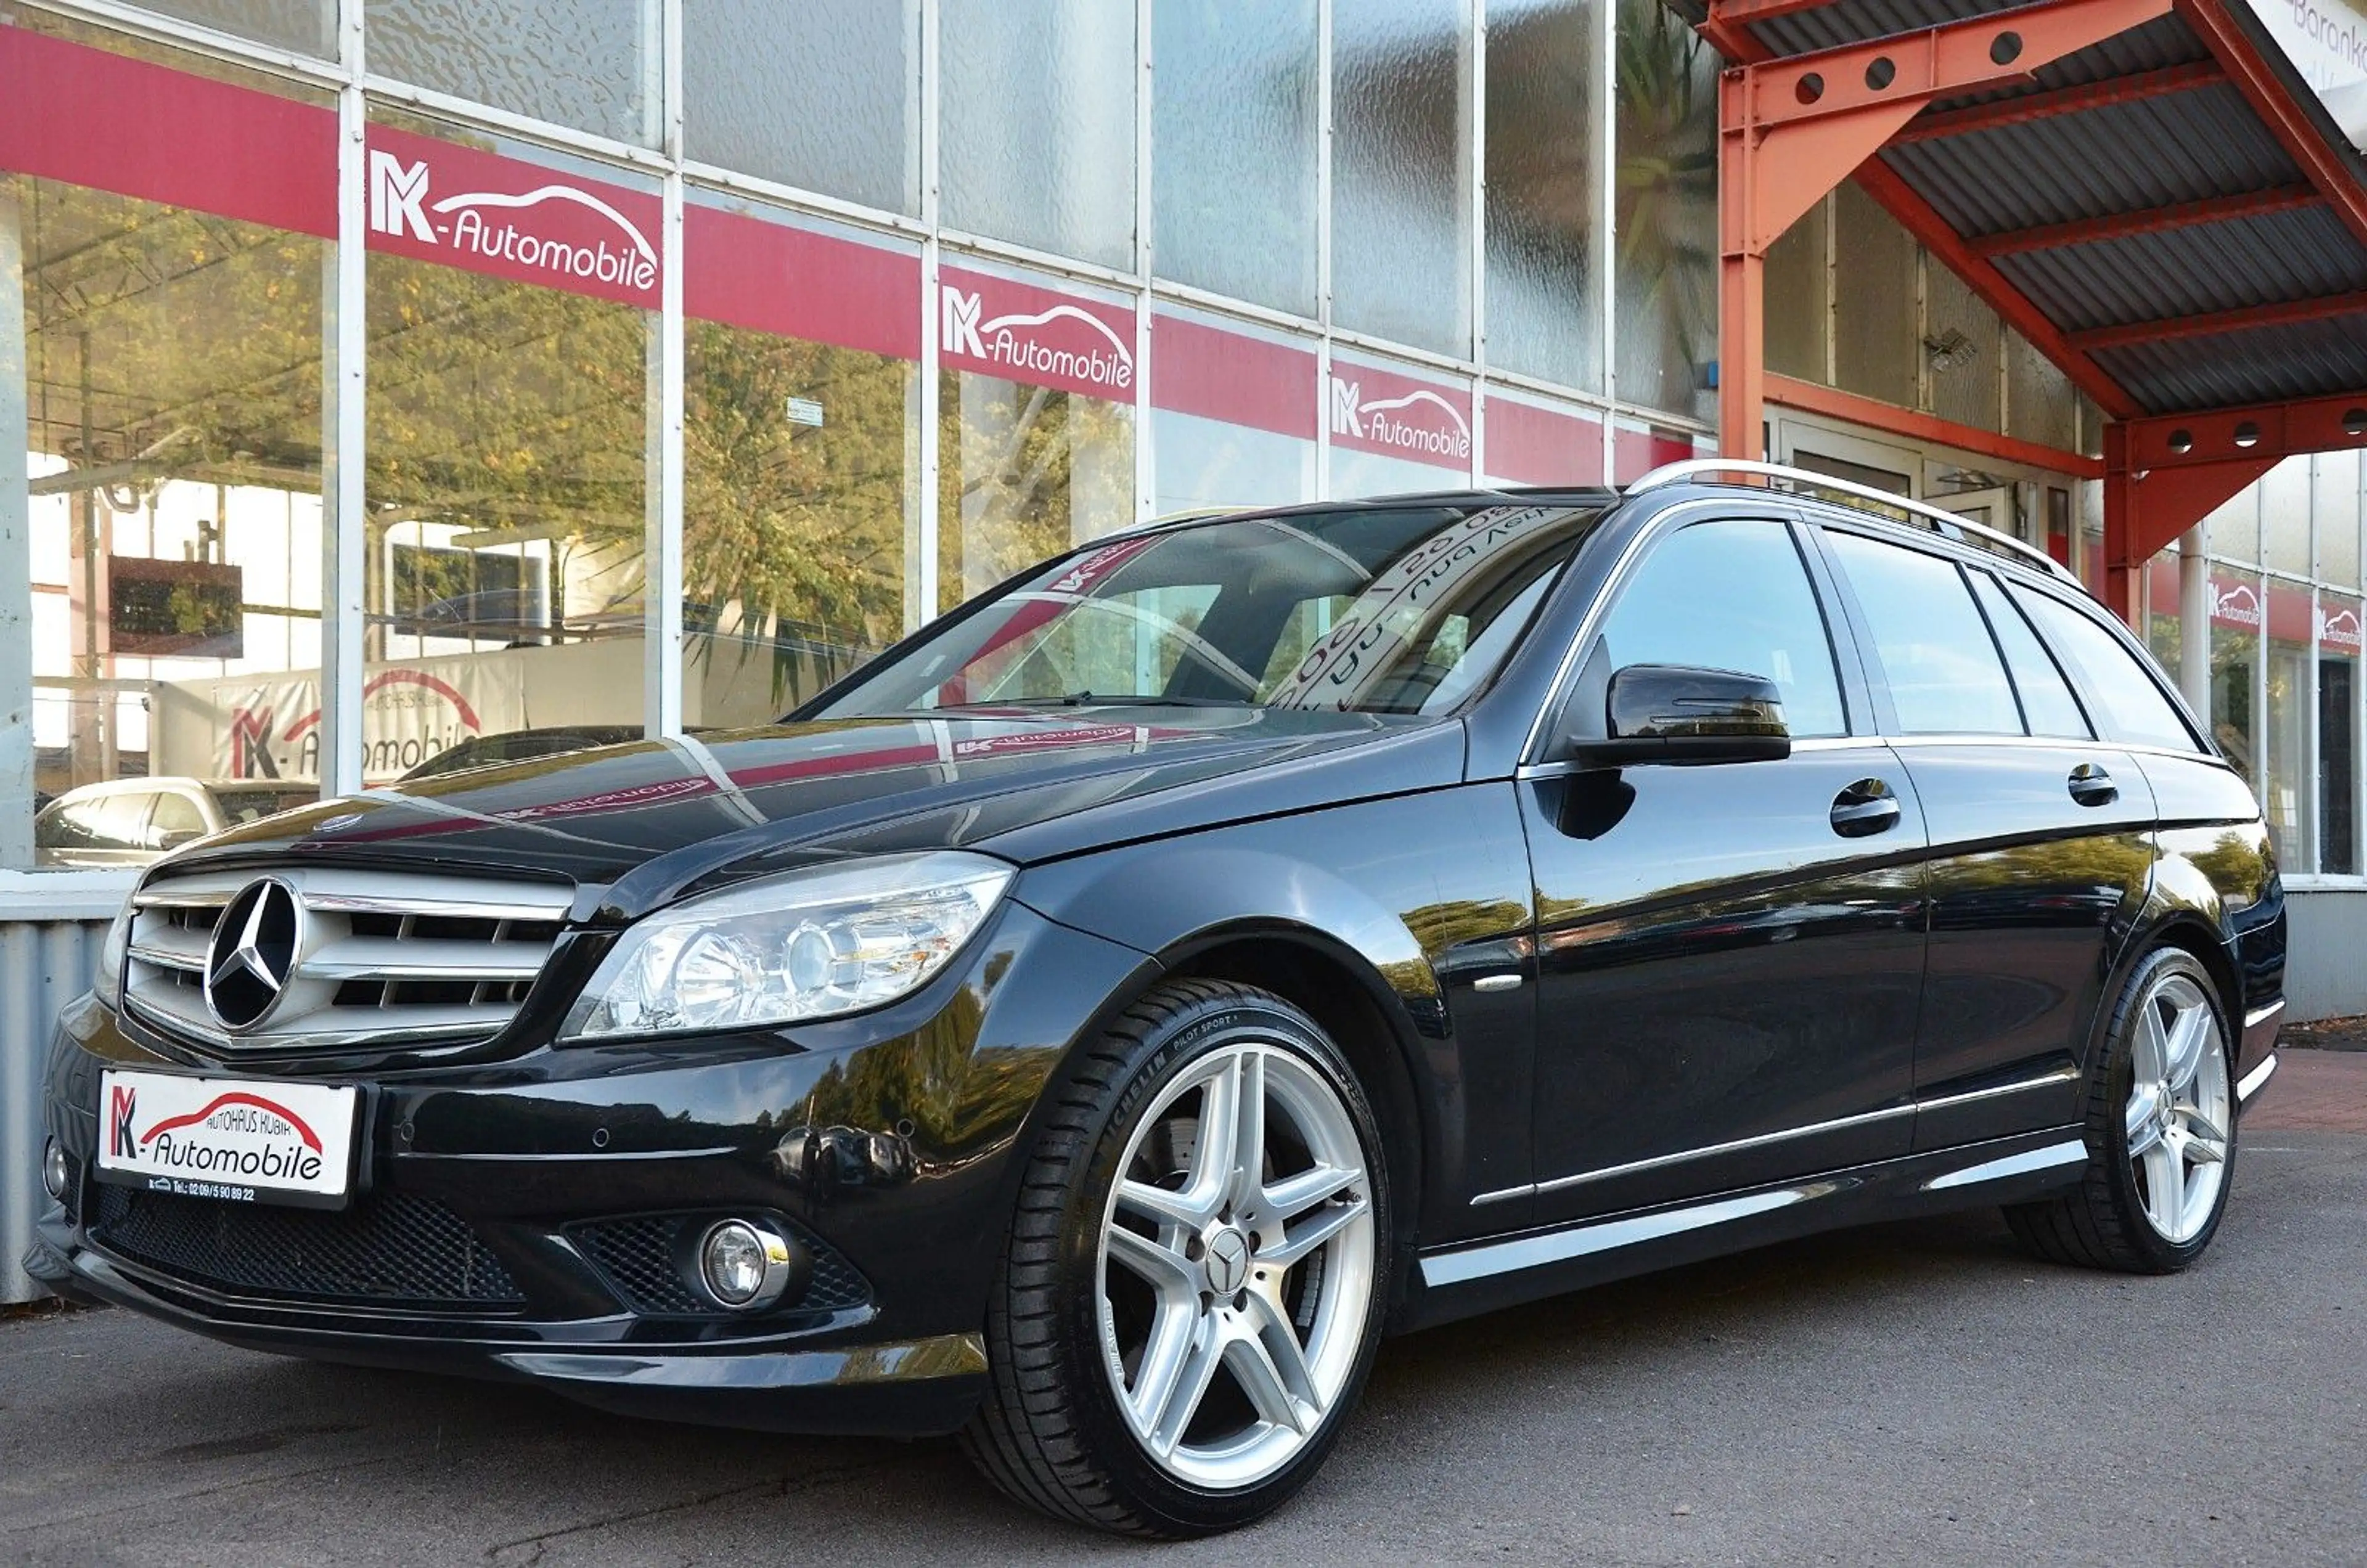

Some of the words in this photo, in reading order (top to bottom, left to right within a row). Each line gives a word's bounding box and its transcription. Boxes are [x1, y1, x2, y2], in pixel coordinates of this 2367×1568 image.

[1173, 1027, 1199, 1050] PILOT
[1201, 1015, 1232, 1033] SPORT
[206, 1109, 256, 1133] AUTOHAUS
[260, 1113, 291, 1136] KUBIK
